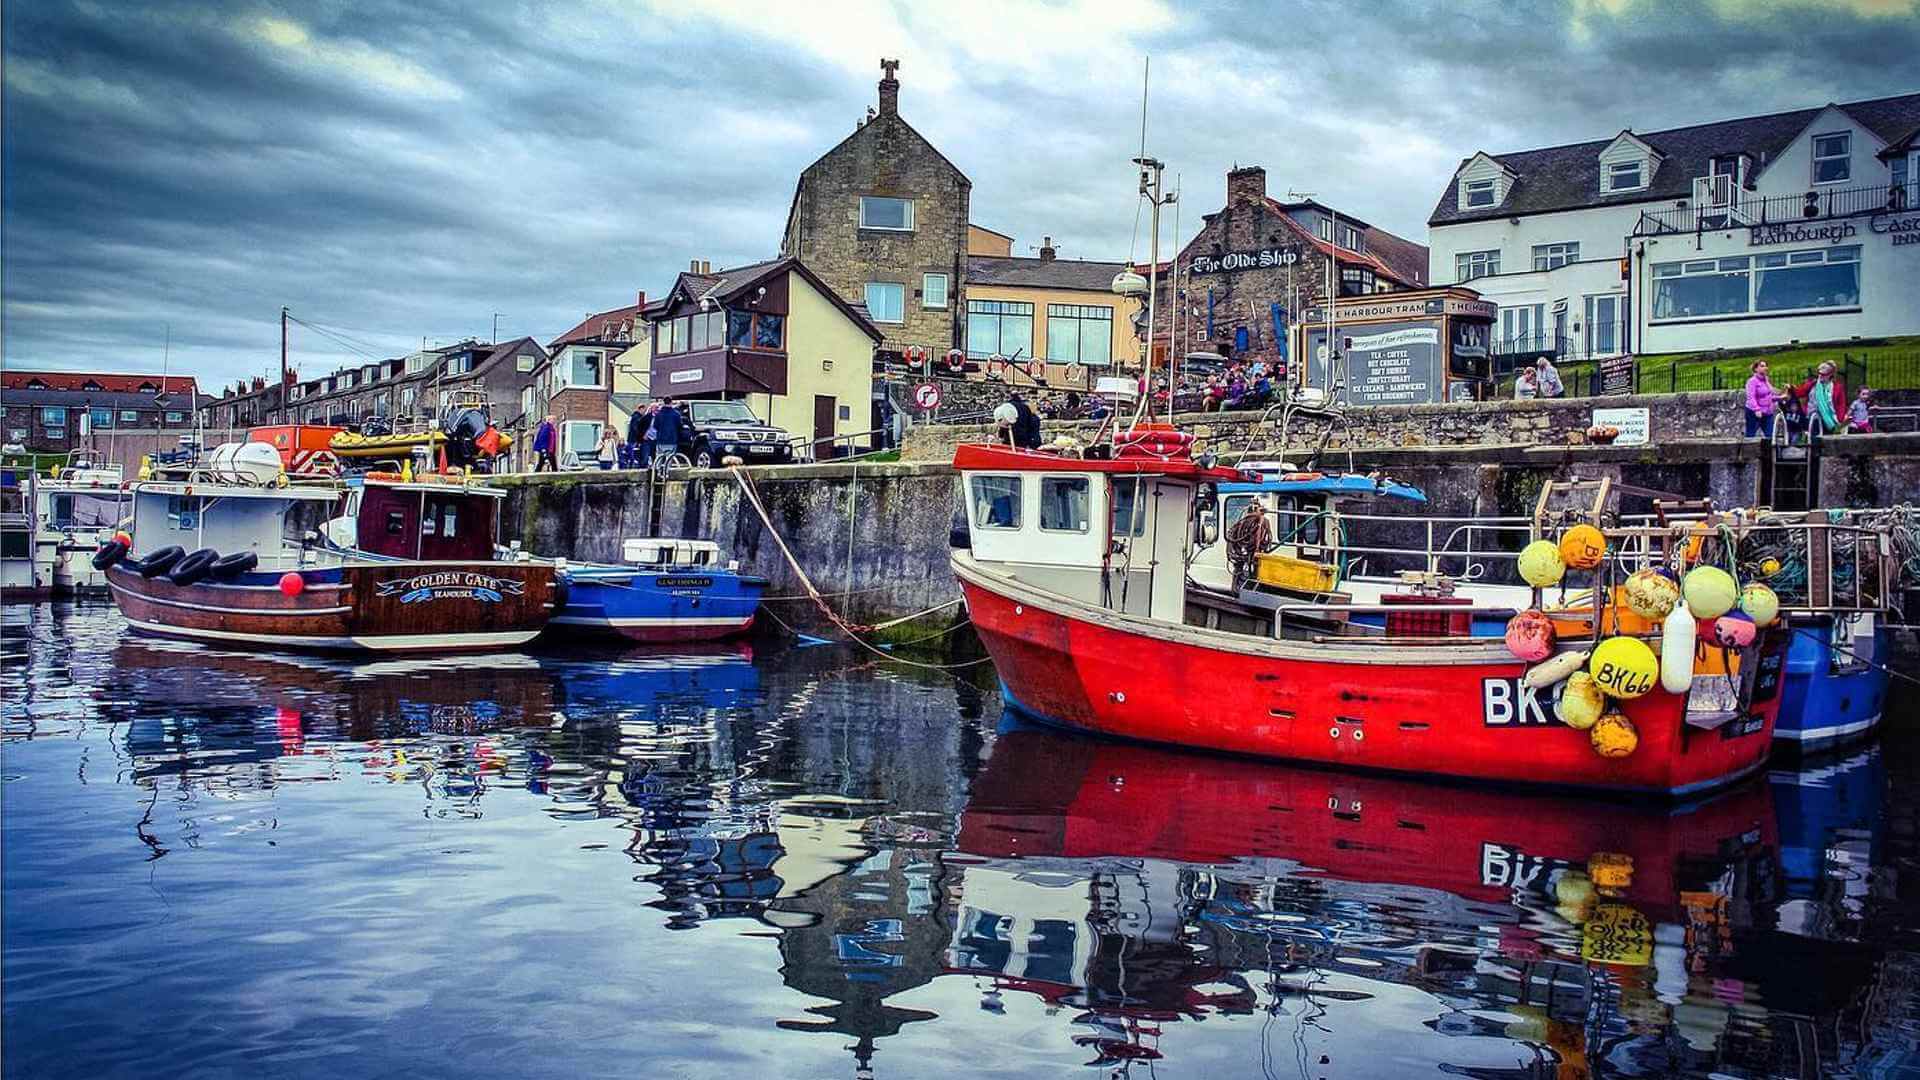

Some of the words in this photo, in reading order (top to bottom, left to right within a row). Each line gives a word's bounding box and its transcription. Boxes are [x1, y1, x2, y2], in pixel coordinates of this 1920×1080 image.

[1193, 255, 1220, 273] The
[1222, 252, 1257, 270] Olde
[1259, 248, 1297, 268] Ship
[1323, 311, 1341, 319] TE
[1344, 306, 1393, 317] HARBOUR
[1395, 302, 1426, 312] TRAM
[1452, 303, 1470, 312] THE
[410, 573, 461, 589] GOLDEN
[465, 573, 497, 590] GATE
[1597, 662, 1650, 694] BK66
